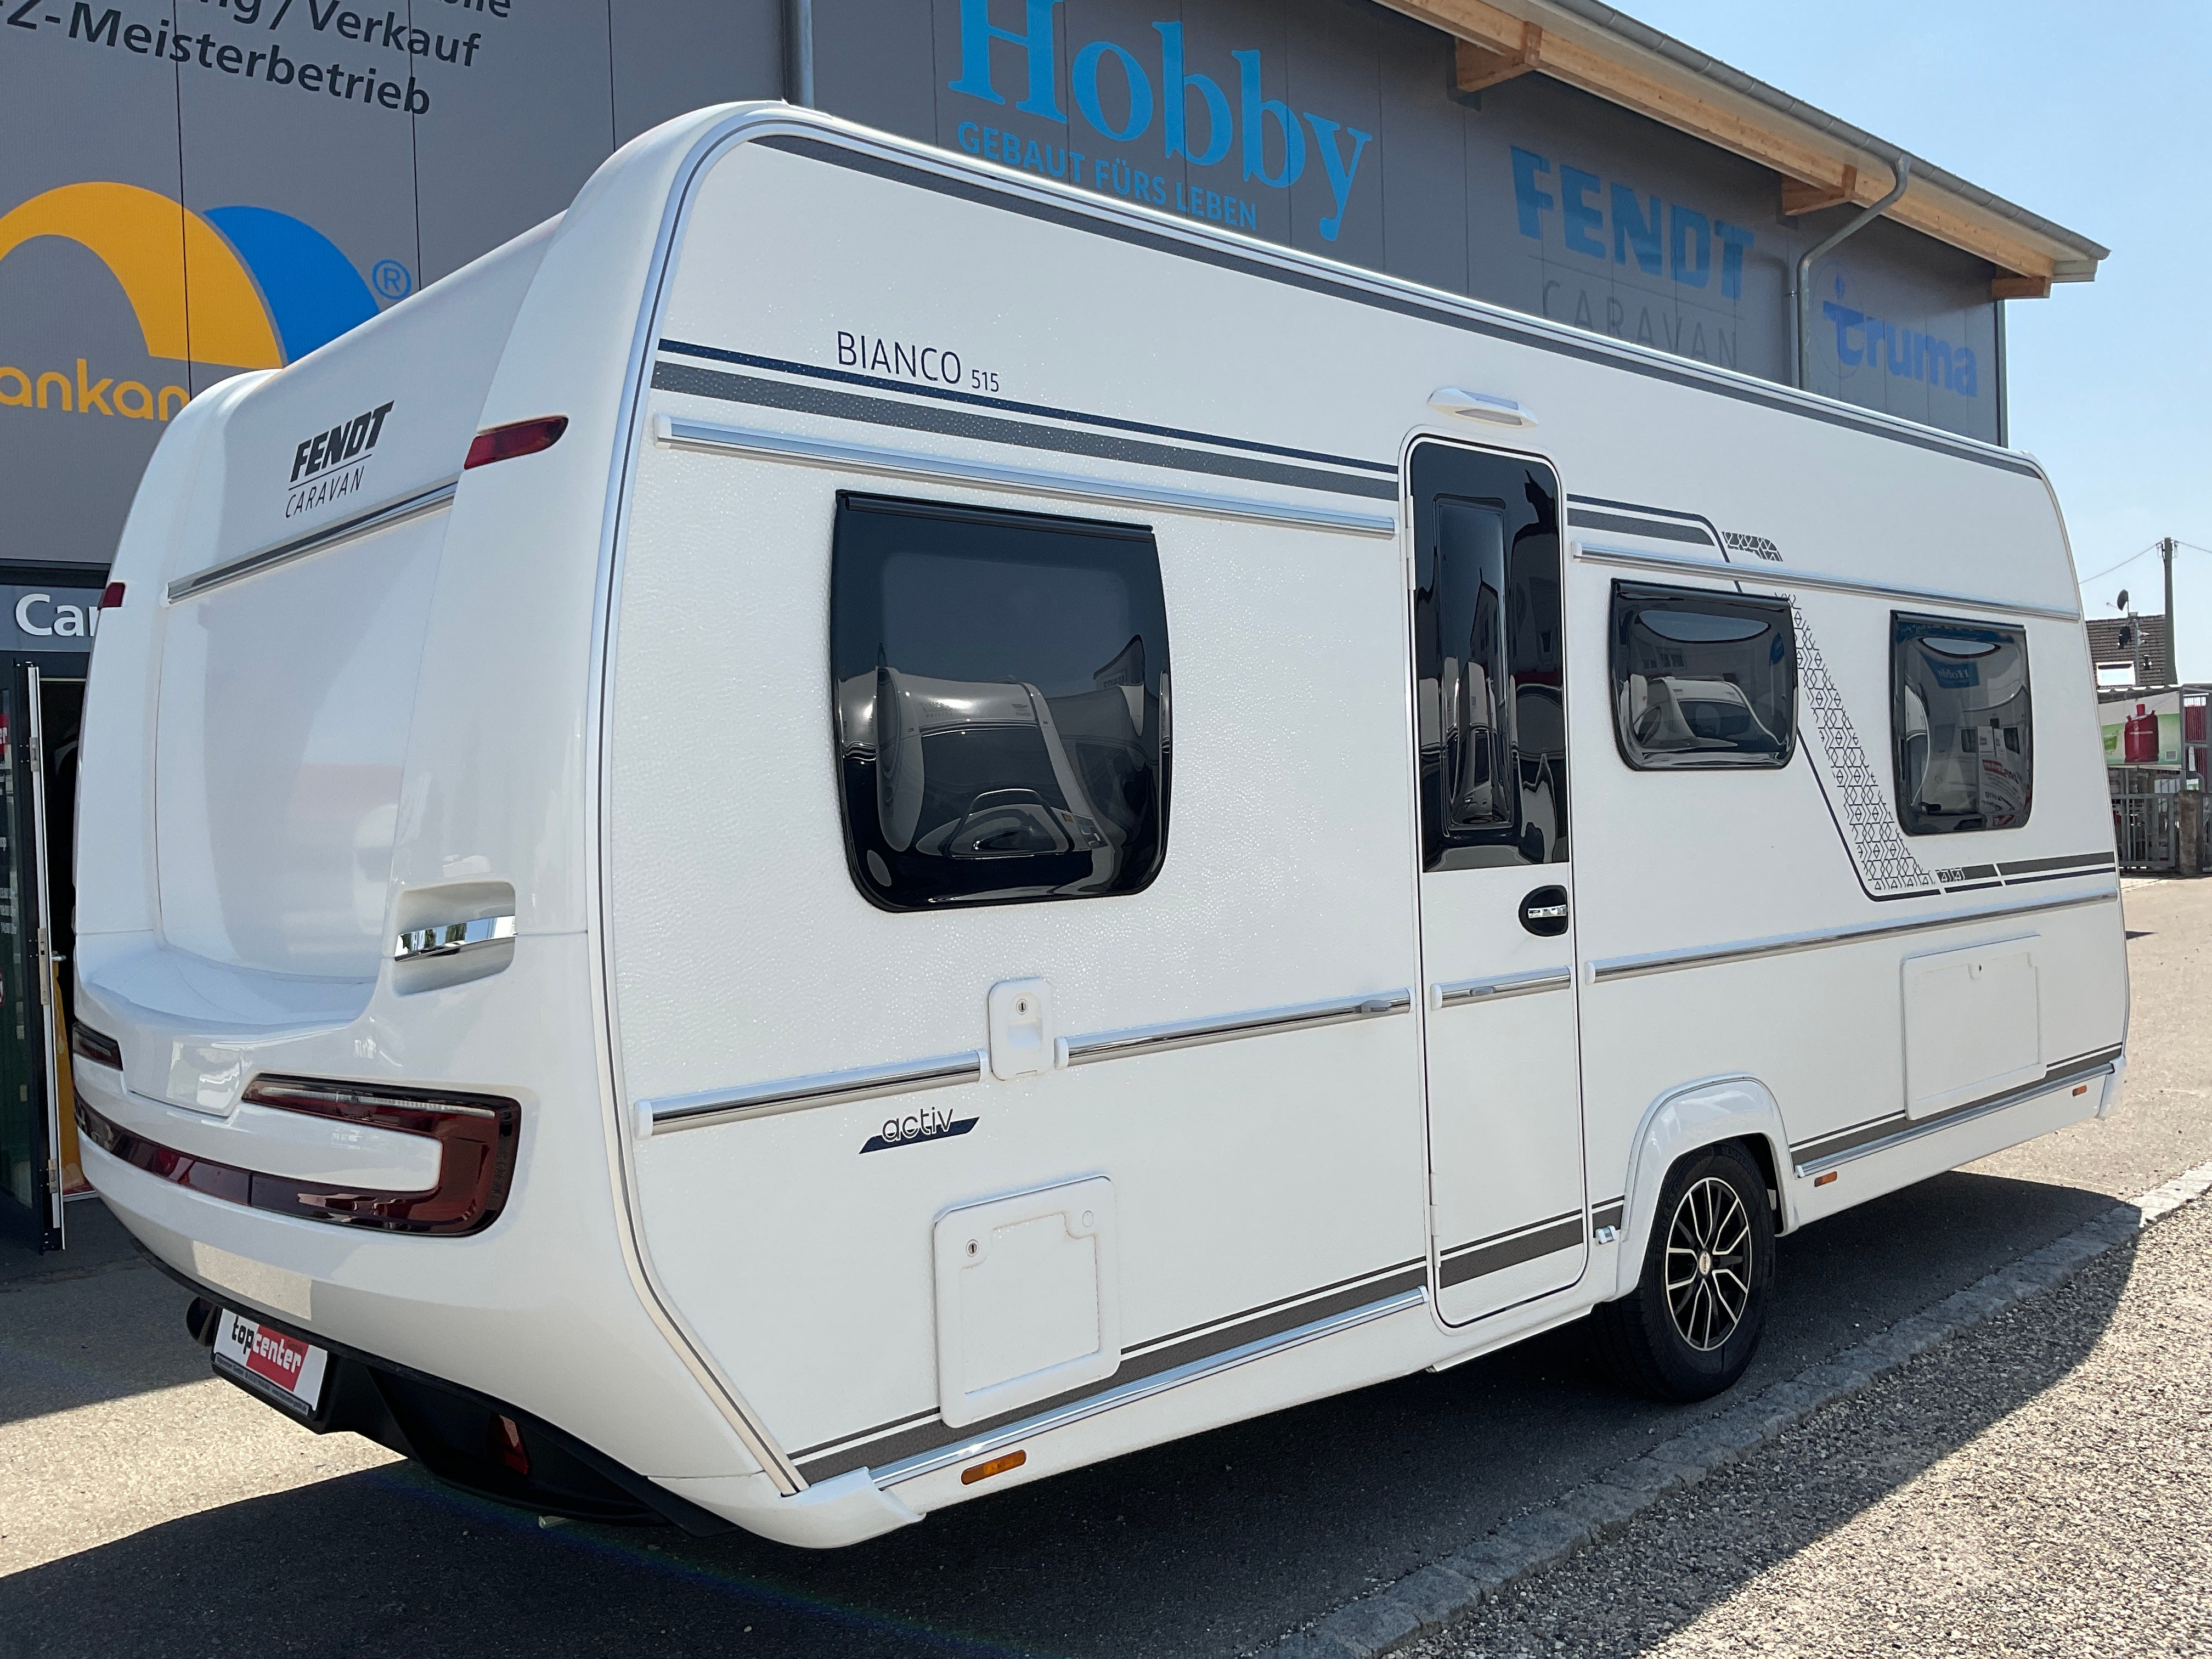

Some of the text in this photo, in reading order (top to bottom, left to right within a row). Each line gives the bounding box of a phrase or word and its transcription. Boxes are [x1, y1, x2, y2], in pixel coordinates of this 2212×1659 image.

[0, 0, 430, 115] Z-Meisterbetrieb
[308, 0, 481, 67] Verkauf
[948, 0, 1373, 241] Hobby
[957, 121, 1257, 231] GEBAUT FÜRS LEBEN
[1510, 145, 1754, 301] FENDT
[837, 330, 1000, 392] BIANCO 515
[1542, 280, 1738, 369] CARAVAN
[1822, 300, 1978, 398] truma
[290, 400, 395, 483] FENDT
[285, 466, 365, 518] CARAVAN
[882, 1106, 954, 1142] activ
[231, 1316, 302, 1374] topcenter
